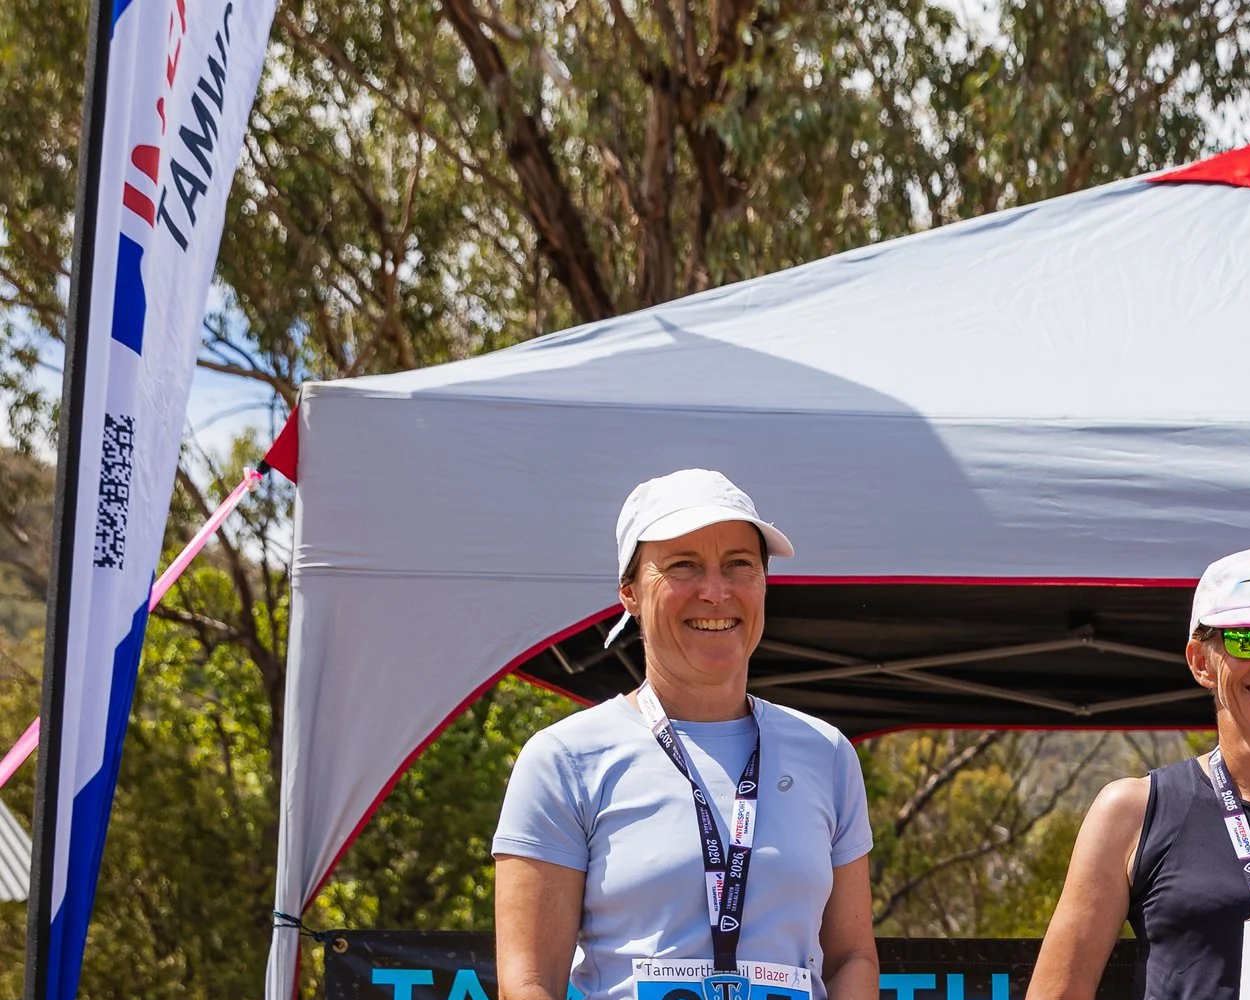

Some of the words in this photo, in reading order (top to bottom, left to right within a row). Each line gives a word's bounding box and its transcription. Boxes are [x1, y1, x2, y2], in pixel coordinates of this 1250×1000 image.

[735, 800, 746, 839] INTERSPORT
[706, 838, 721, 865] 2026
[730, 852, 745, 879] 2026
[644, 963, 714, 978] Tamworth
[754, 966, 789, 983] Blazer
